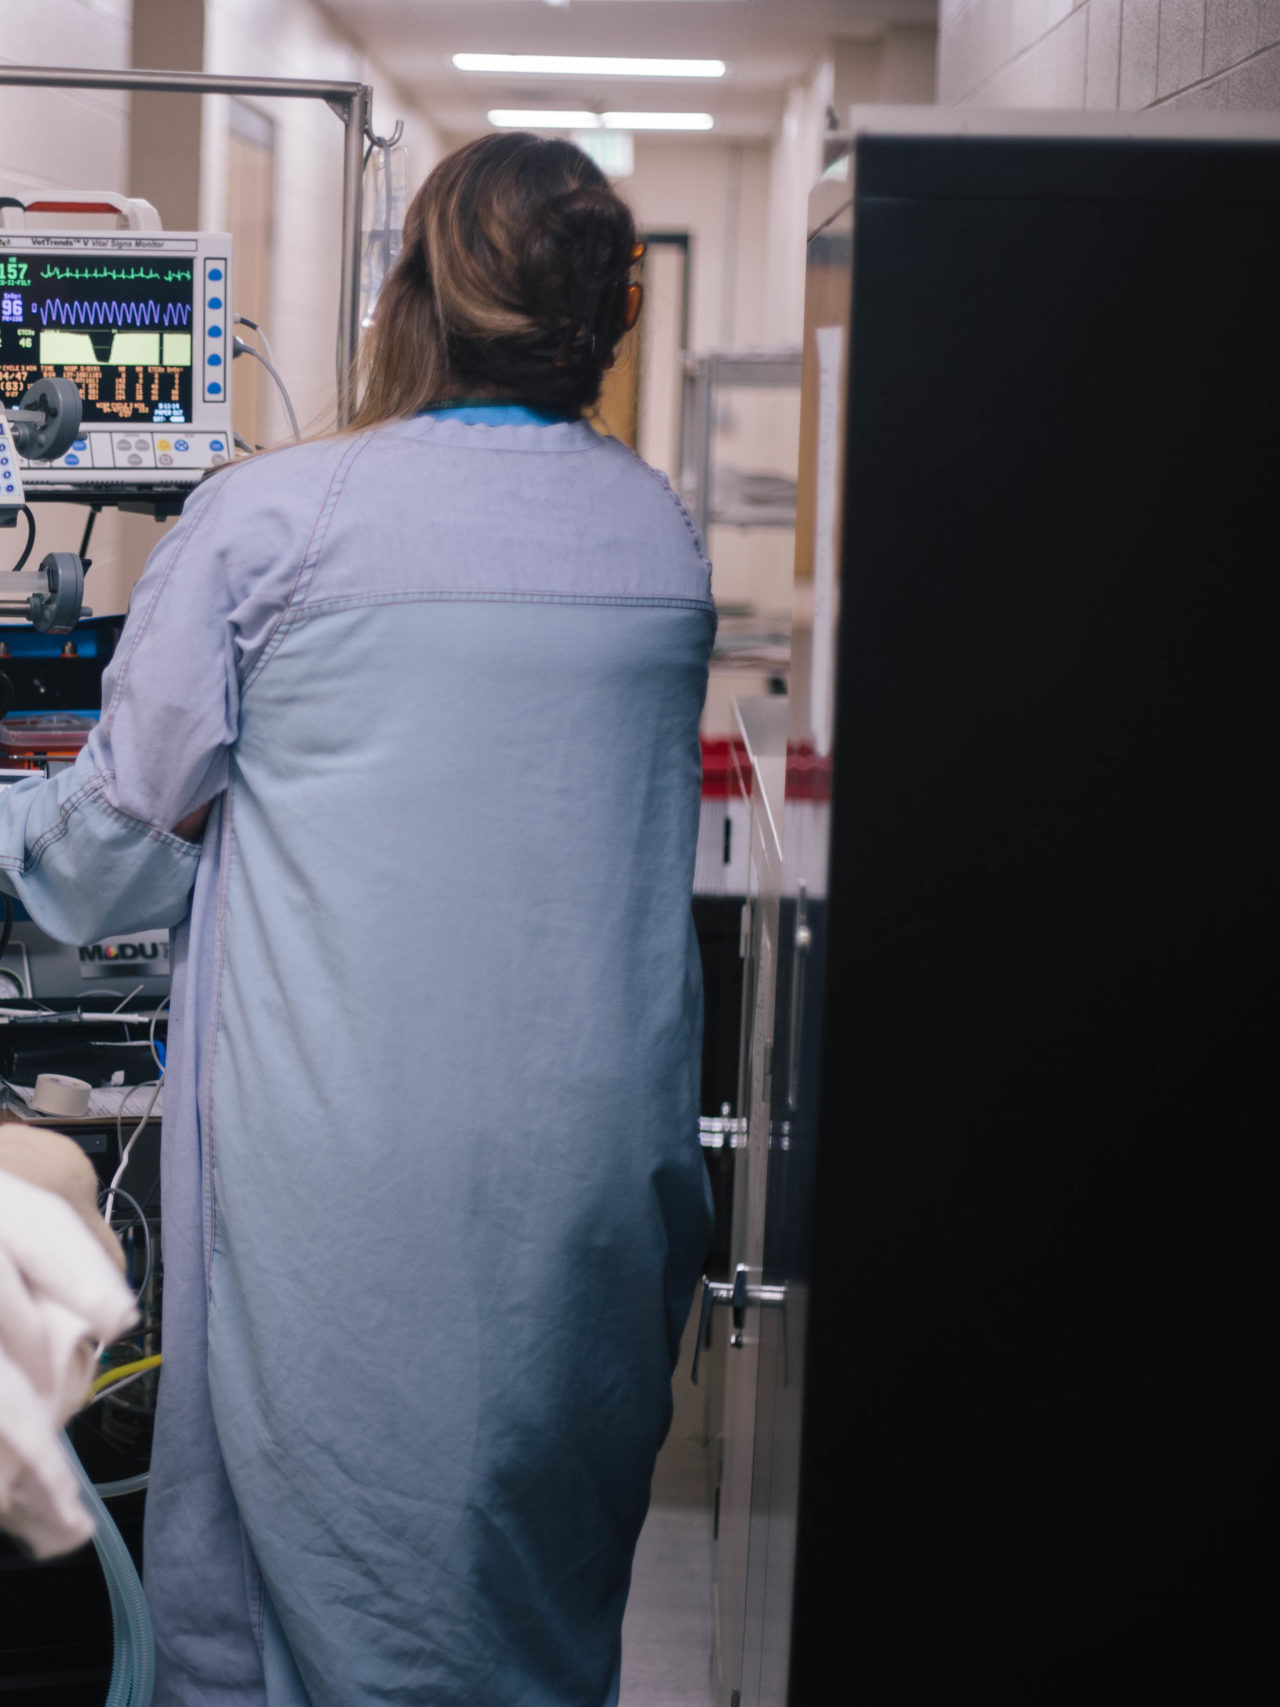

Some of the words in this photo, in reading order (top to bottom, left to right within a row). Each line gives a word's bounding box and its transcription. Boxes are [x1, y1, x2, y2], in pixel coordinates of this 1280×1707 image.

[91, 239, 109, 247] Vital
[111, 240, 133, 250] Signs
[134, 240, 166, 248] Monitor
[2, 299, 23, 316] 96
[18, 337, 33, 348] 46
[0, 381, 24, 391] (63)
